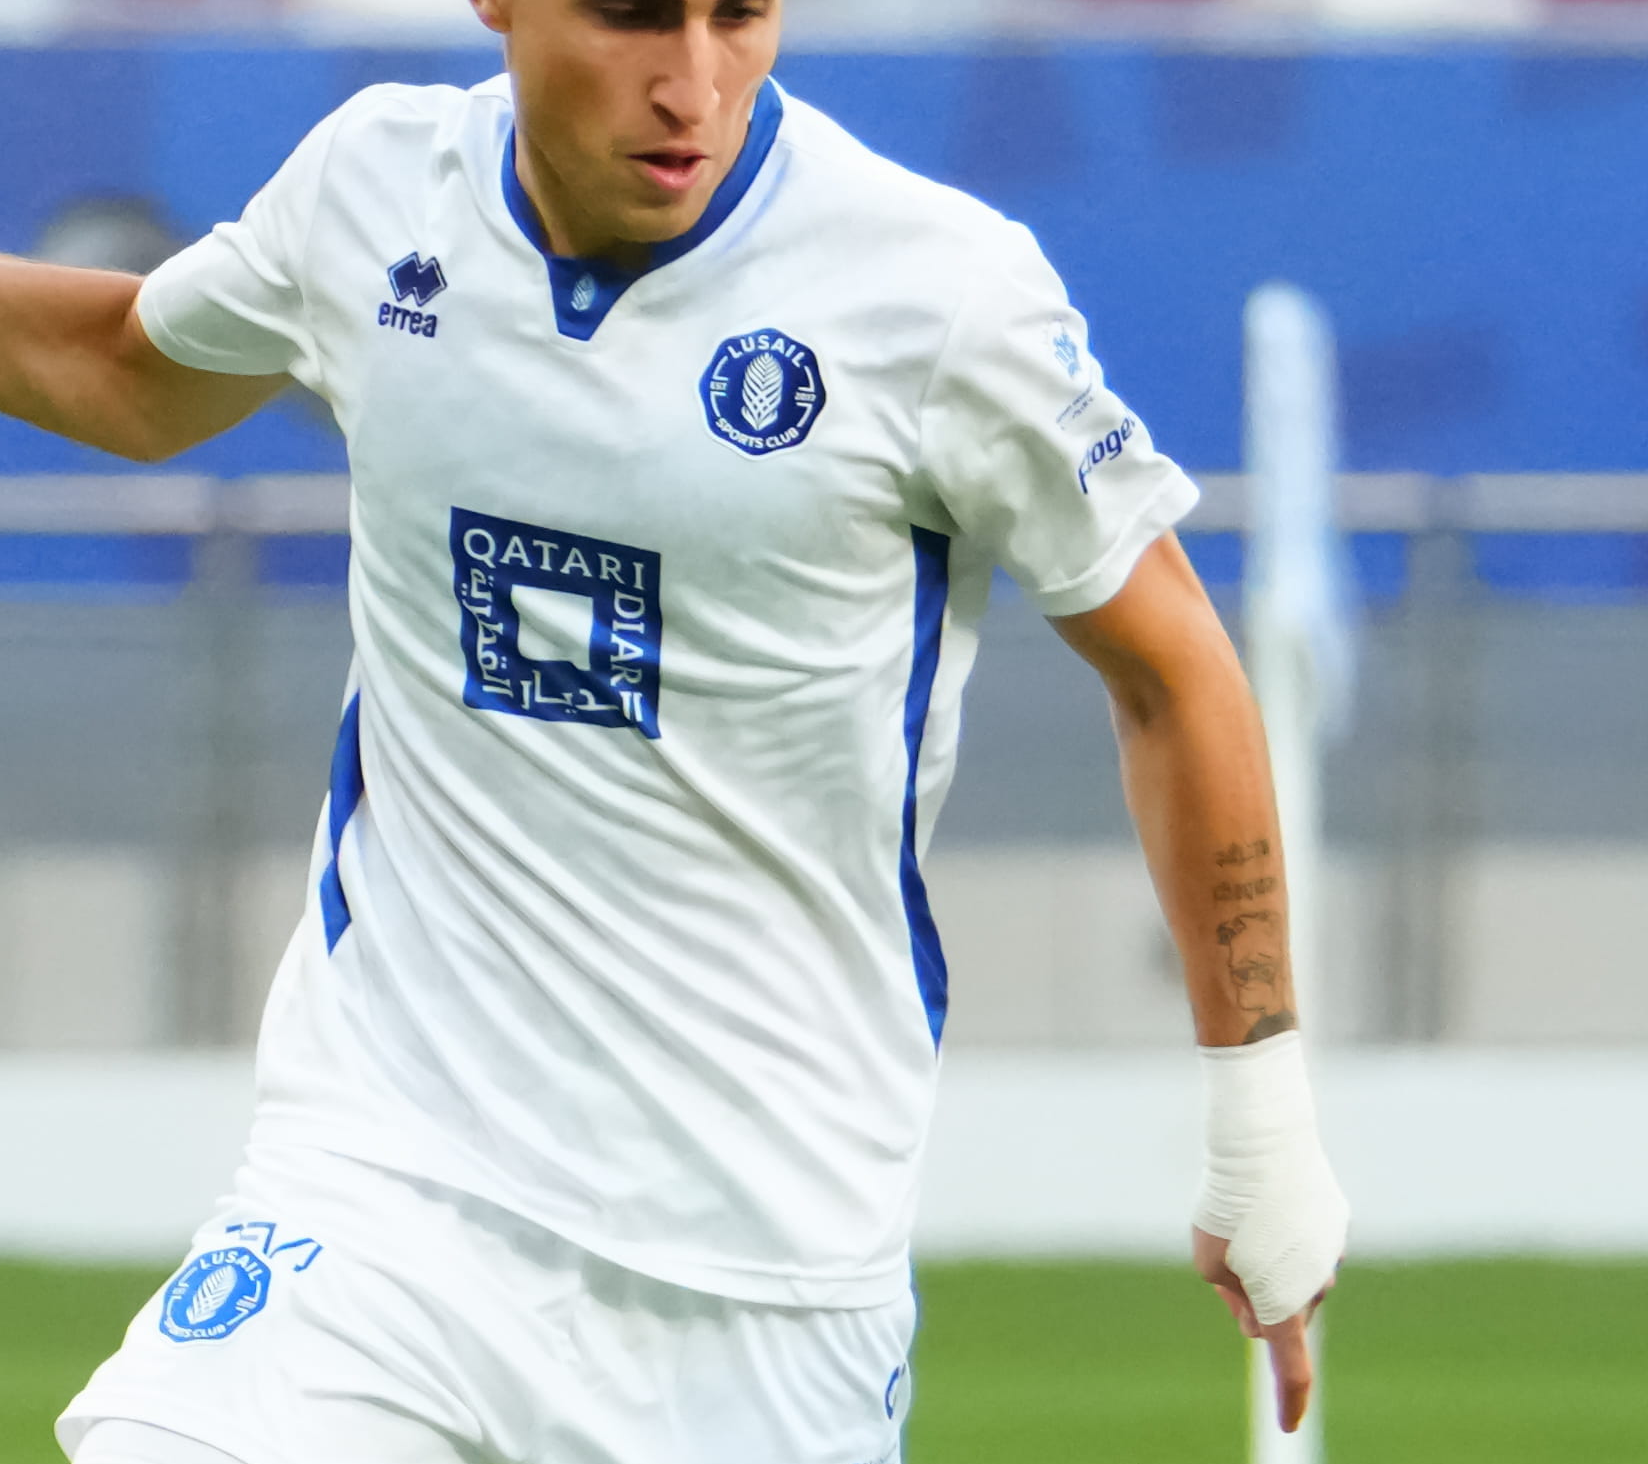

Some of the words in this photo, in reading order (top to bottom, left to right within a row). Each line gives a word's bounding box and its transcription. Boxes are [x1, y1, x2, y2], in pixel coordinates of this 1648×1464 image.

[378, 301, 438, 338] errea
[727, 334, 805, 368] LUSAIL
[715, 417, 764, 448] SPORTS
[765, 427, 799, 448] CLUB
[463, 527, 645, 591] QATARI
[609, 589, 646, 687] DIAR
[199, 1250, 264, 1282] LUSAIL
